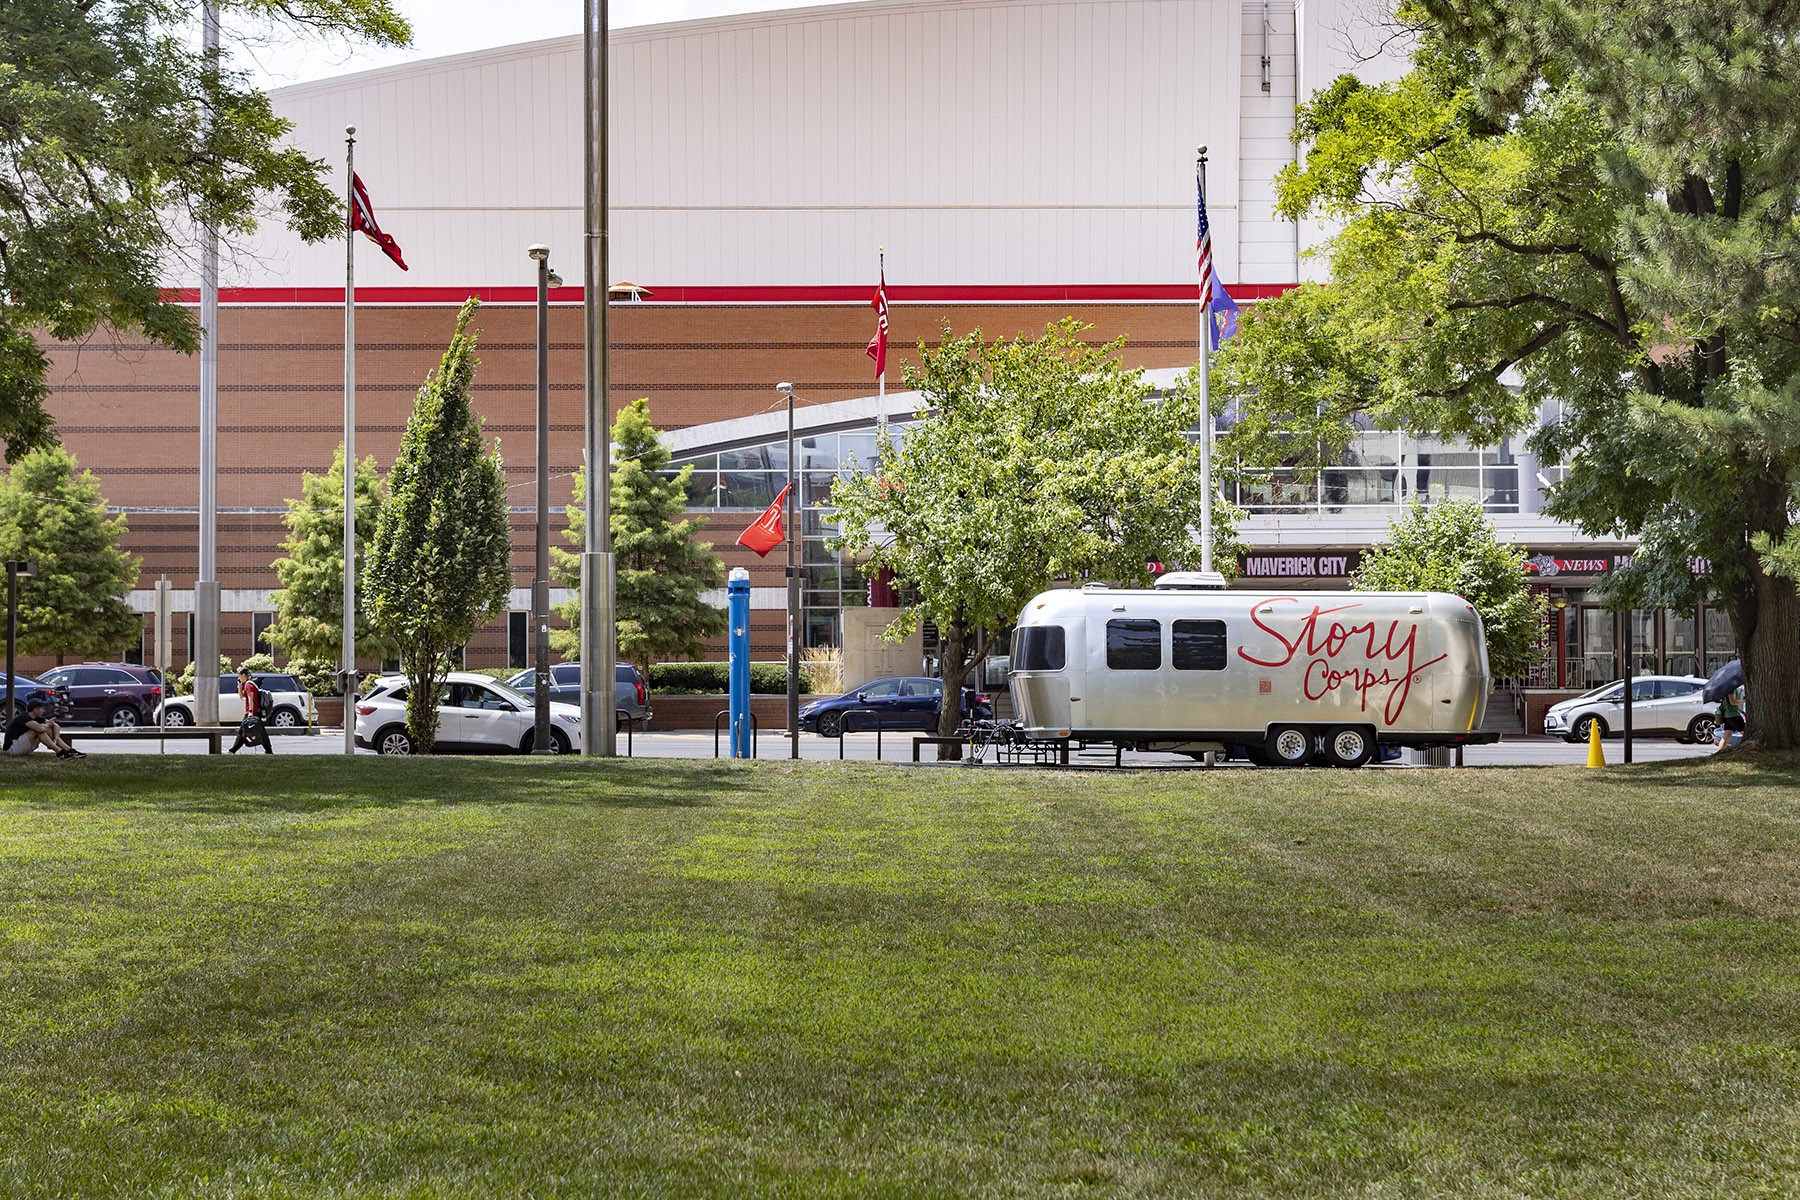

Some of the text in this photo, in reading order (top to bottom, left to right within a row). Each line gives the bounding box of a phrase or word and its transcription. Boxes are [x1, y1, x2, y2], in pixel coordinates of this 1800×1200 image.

[1246, 557, 1348, 576] MAVERICK CITY
[1562, 559, 1604, 571] NEWS
[1237, 597, 1448, 725] Story
[1304, 658, 1399, 712] Corps
